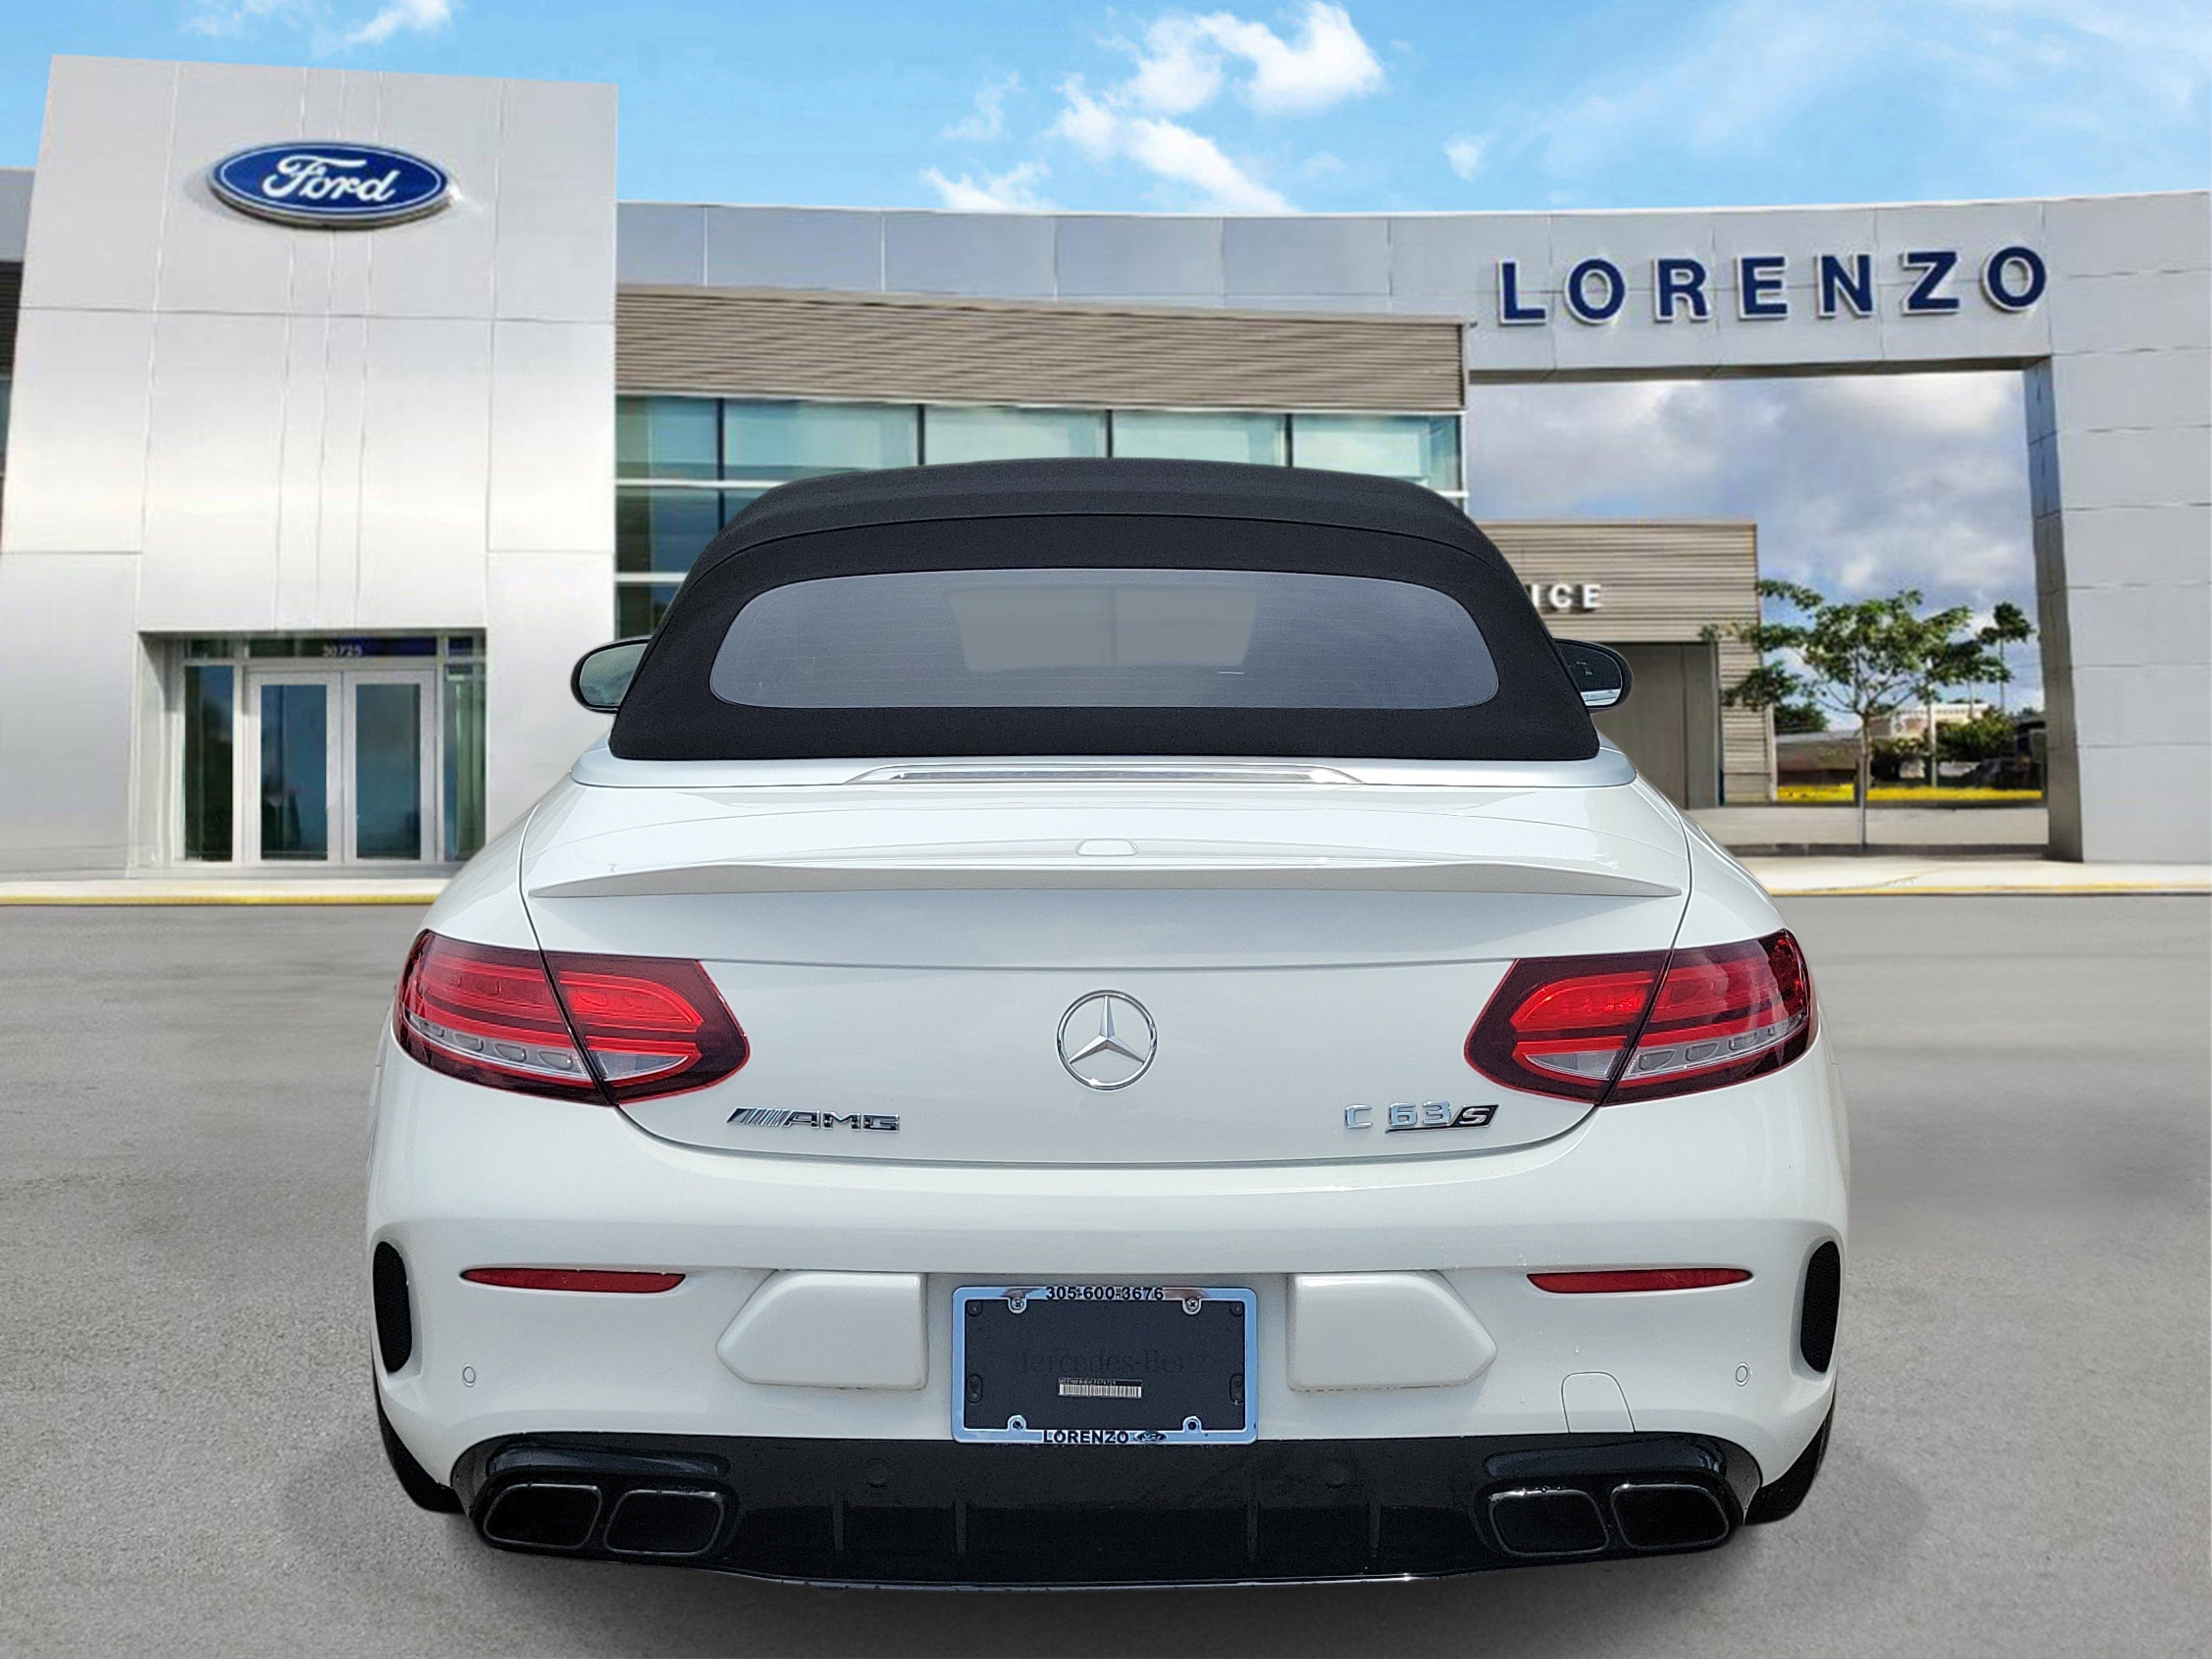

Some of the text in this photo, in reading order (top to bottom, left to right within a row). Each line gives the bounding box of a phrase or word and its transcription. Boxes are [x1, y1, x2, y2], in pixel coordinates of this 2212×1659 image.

[262, 155, 400, 202] Ford
[1498, 247, 2047, 323] LORENZO
[781, 1110, 899, 1132] AMG
[1345, 1104, 1373, 1128] C
[1046, 1286, 1165, 1300] 305-600-3676
[1043, 1430, 1129, 1444] LORENZO
